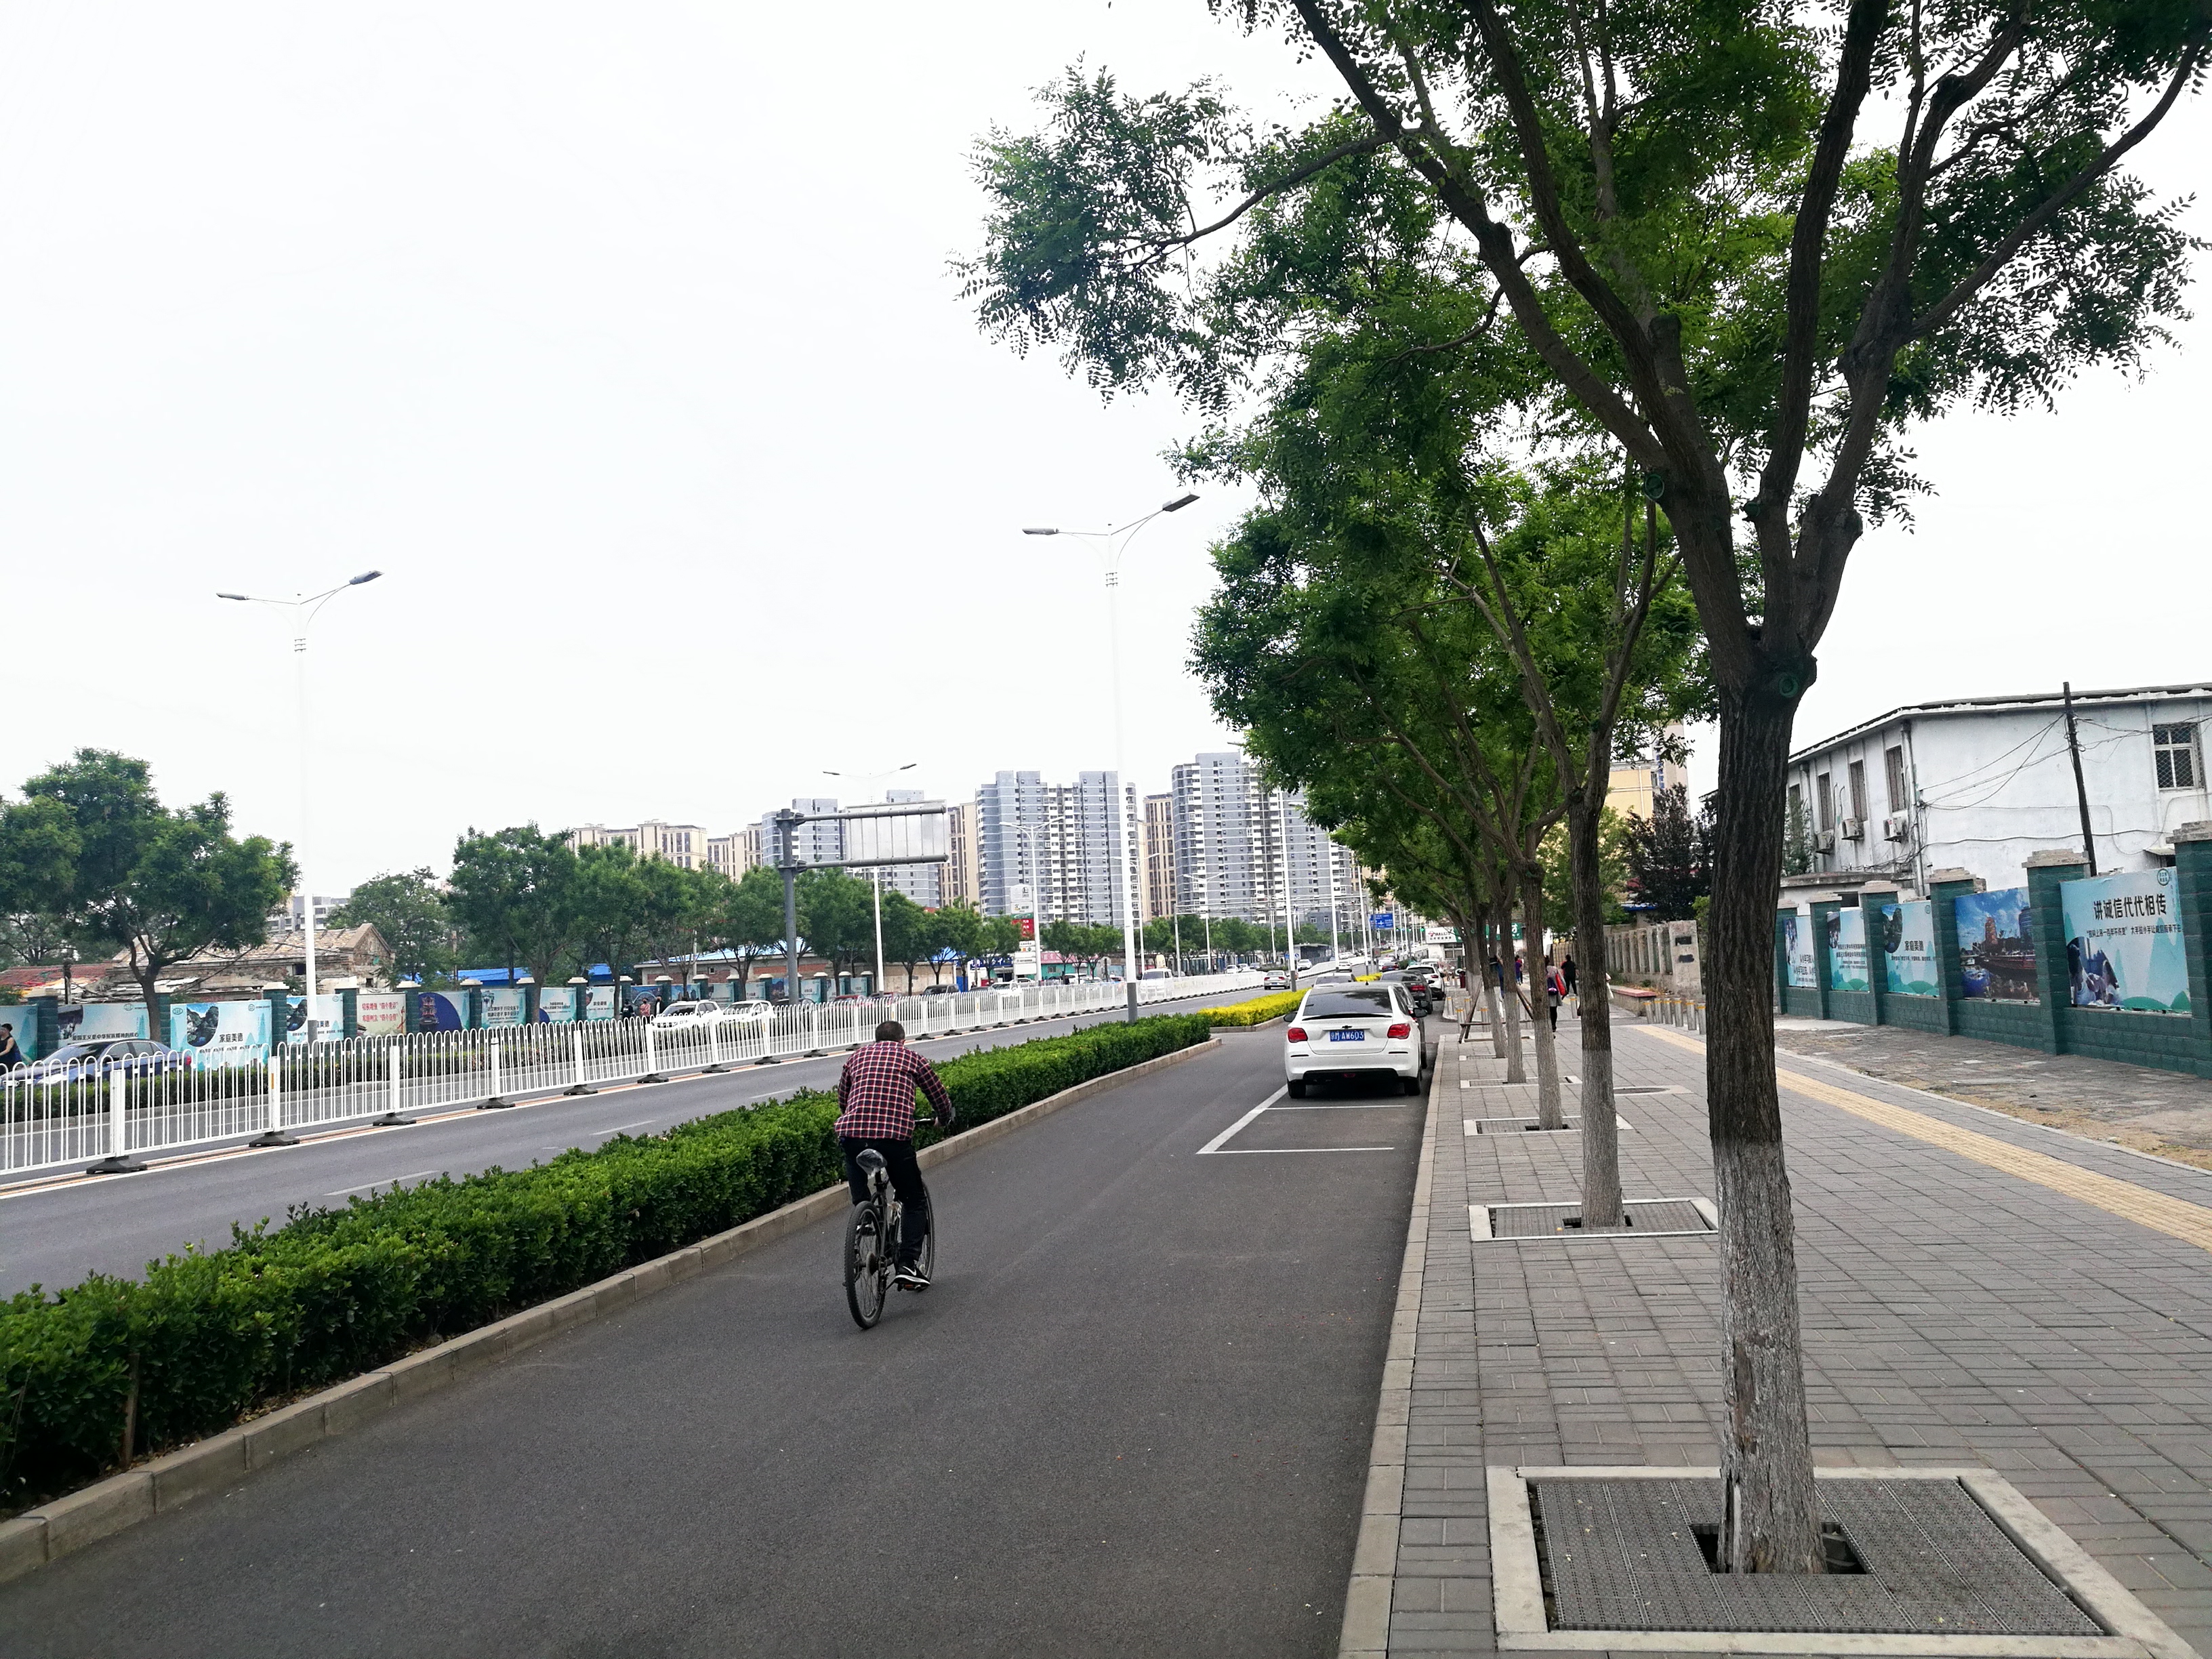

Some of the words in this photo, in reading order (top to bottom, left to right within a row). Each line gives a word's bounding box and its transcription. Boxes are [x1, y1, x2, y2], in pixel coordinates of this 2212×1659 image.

[2093, 893, 2167, 920] 讲诚信代代相传
[219, 1033, 243, 1043] 家庭美德
